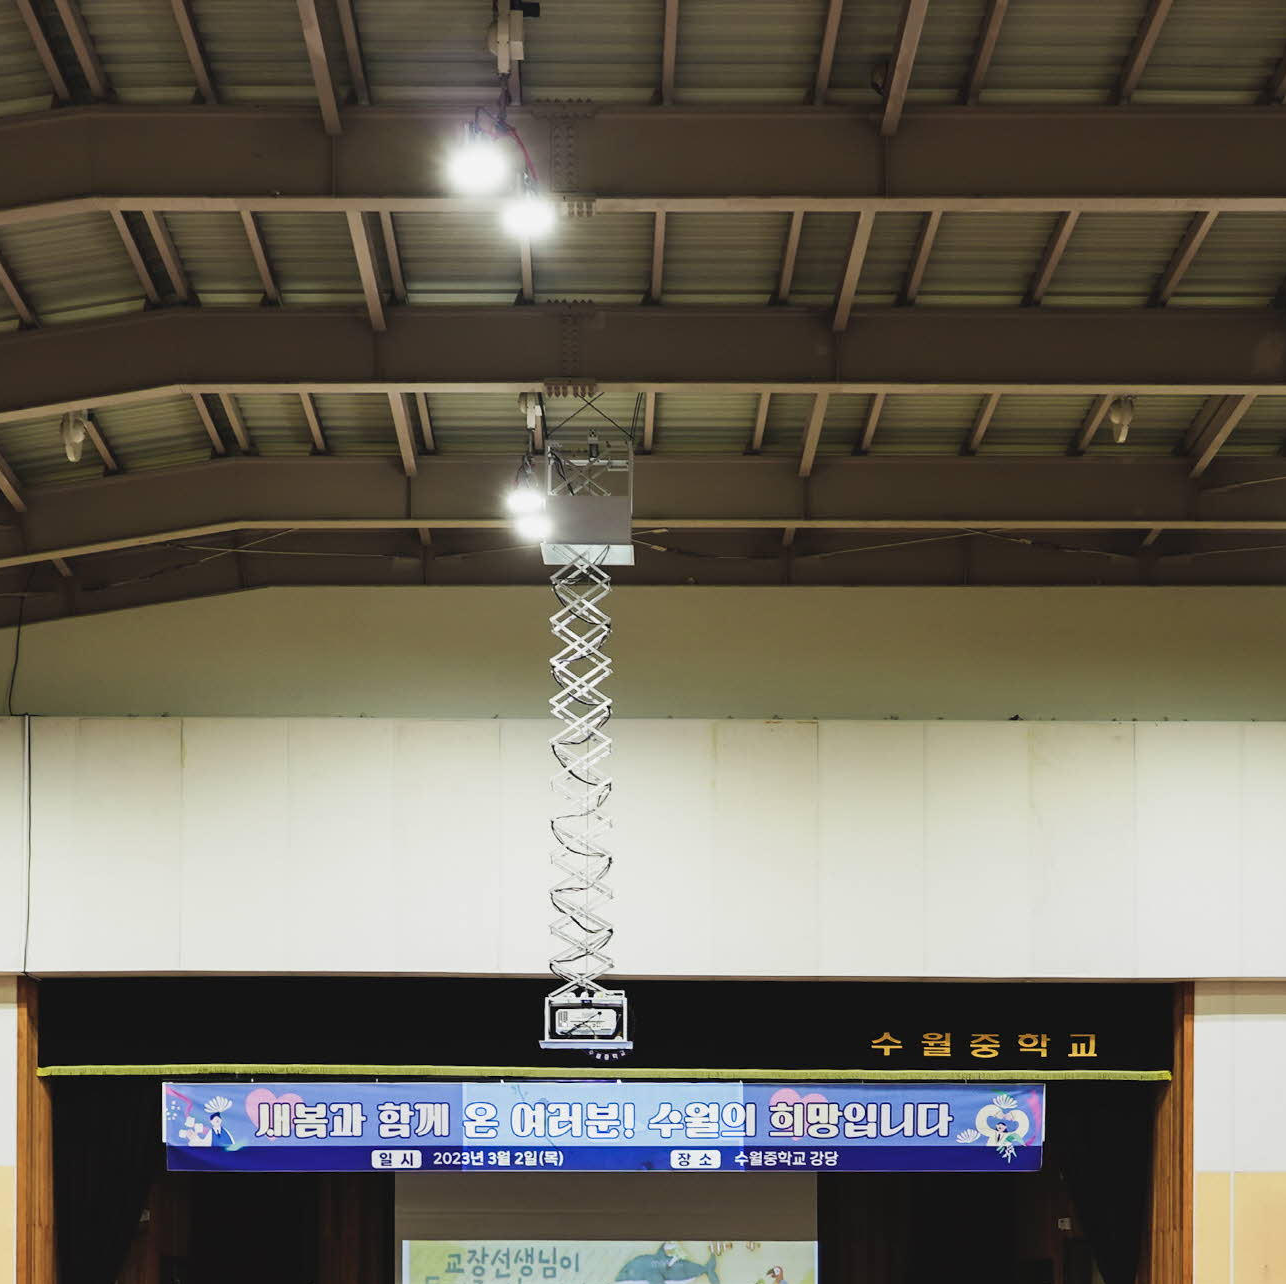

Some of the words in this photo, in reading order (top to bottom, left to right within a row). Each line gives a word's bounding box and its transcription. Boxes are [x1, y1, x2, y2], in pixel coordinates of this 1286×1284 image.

[255, 1102, 367, 1139] 새봄과
[377, 1102, 450, 1139] 함께
[463, 1102, 500, 1139] 온
[510, 1102, 635, 1139] 여러분!
[648, 1102, 757, 1139] 수월의
[769, 1102, 954, 1139] 희망입니다
[433, 1151, 484, 1166] 2023년
[487, 1151, 511, 1167] 3월
[514, 1151, 564, 1167] 2일(목)
[734, 1151, 806, 1167] 수월중학교
[810, 1151, 839, 1167] 강당
[445, 1246, 580, 1279] 교장선생님이
